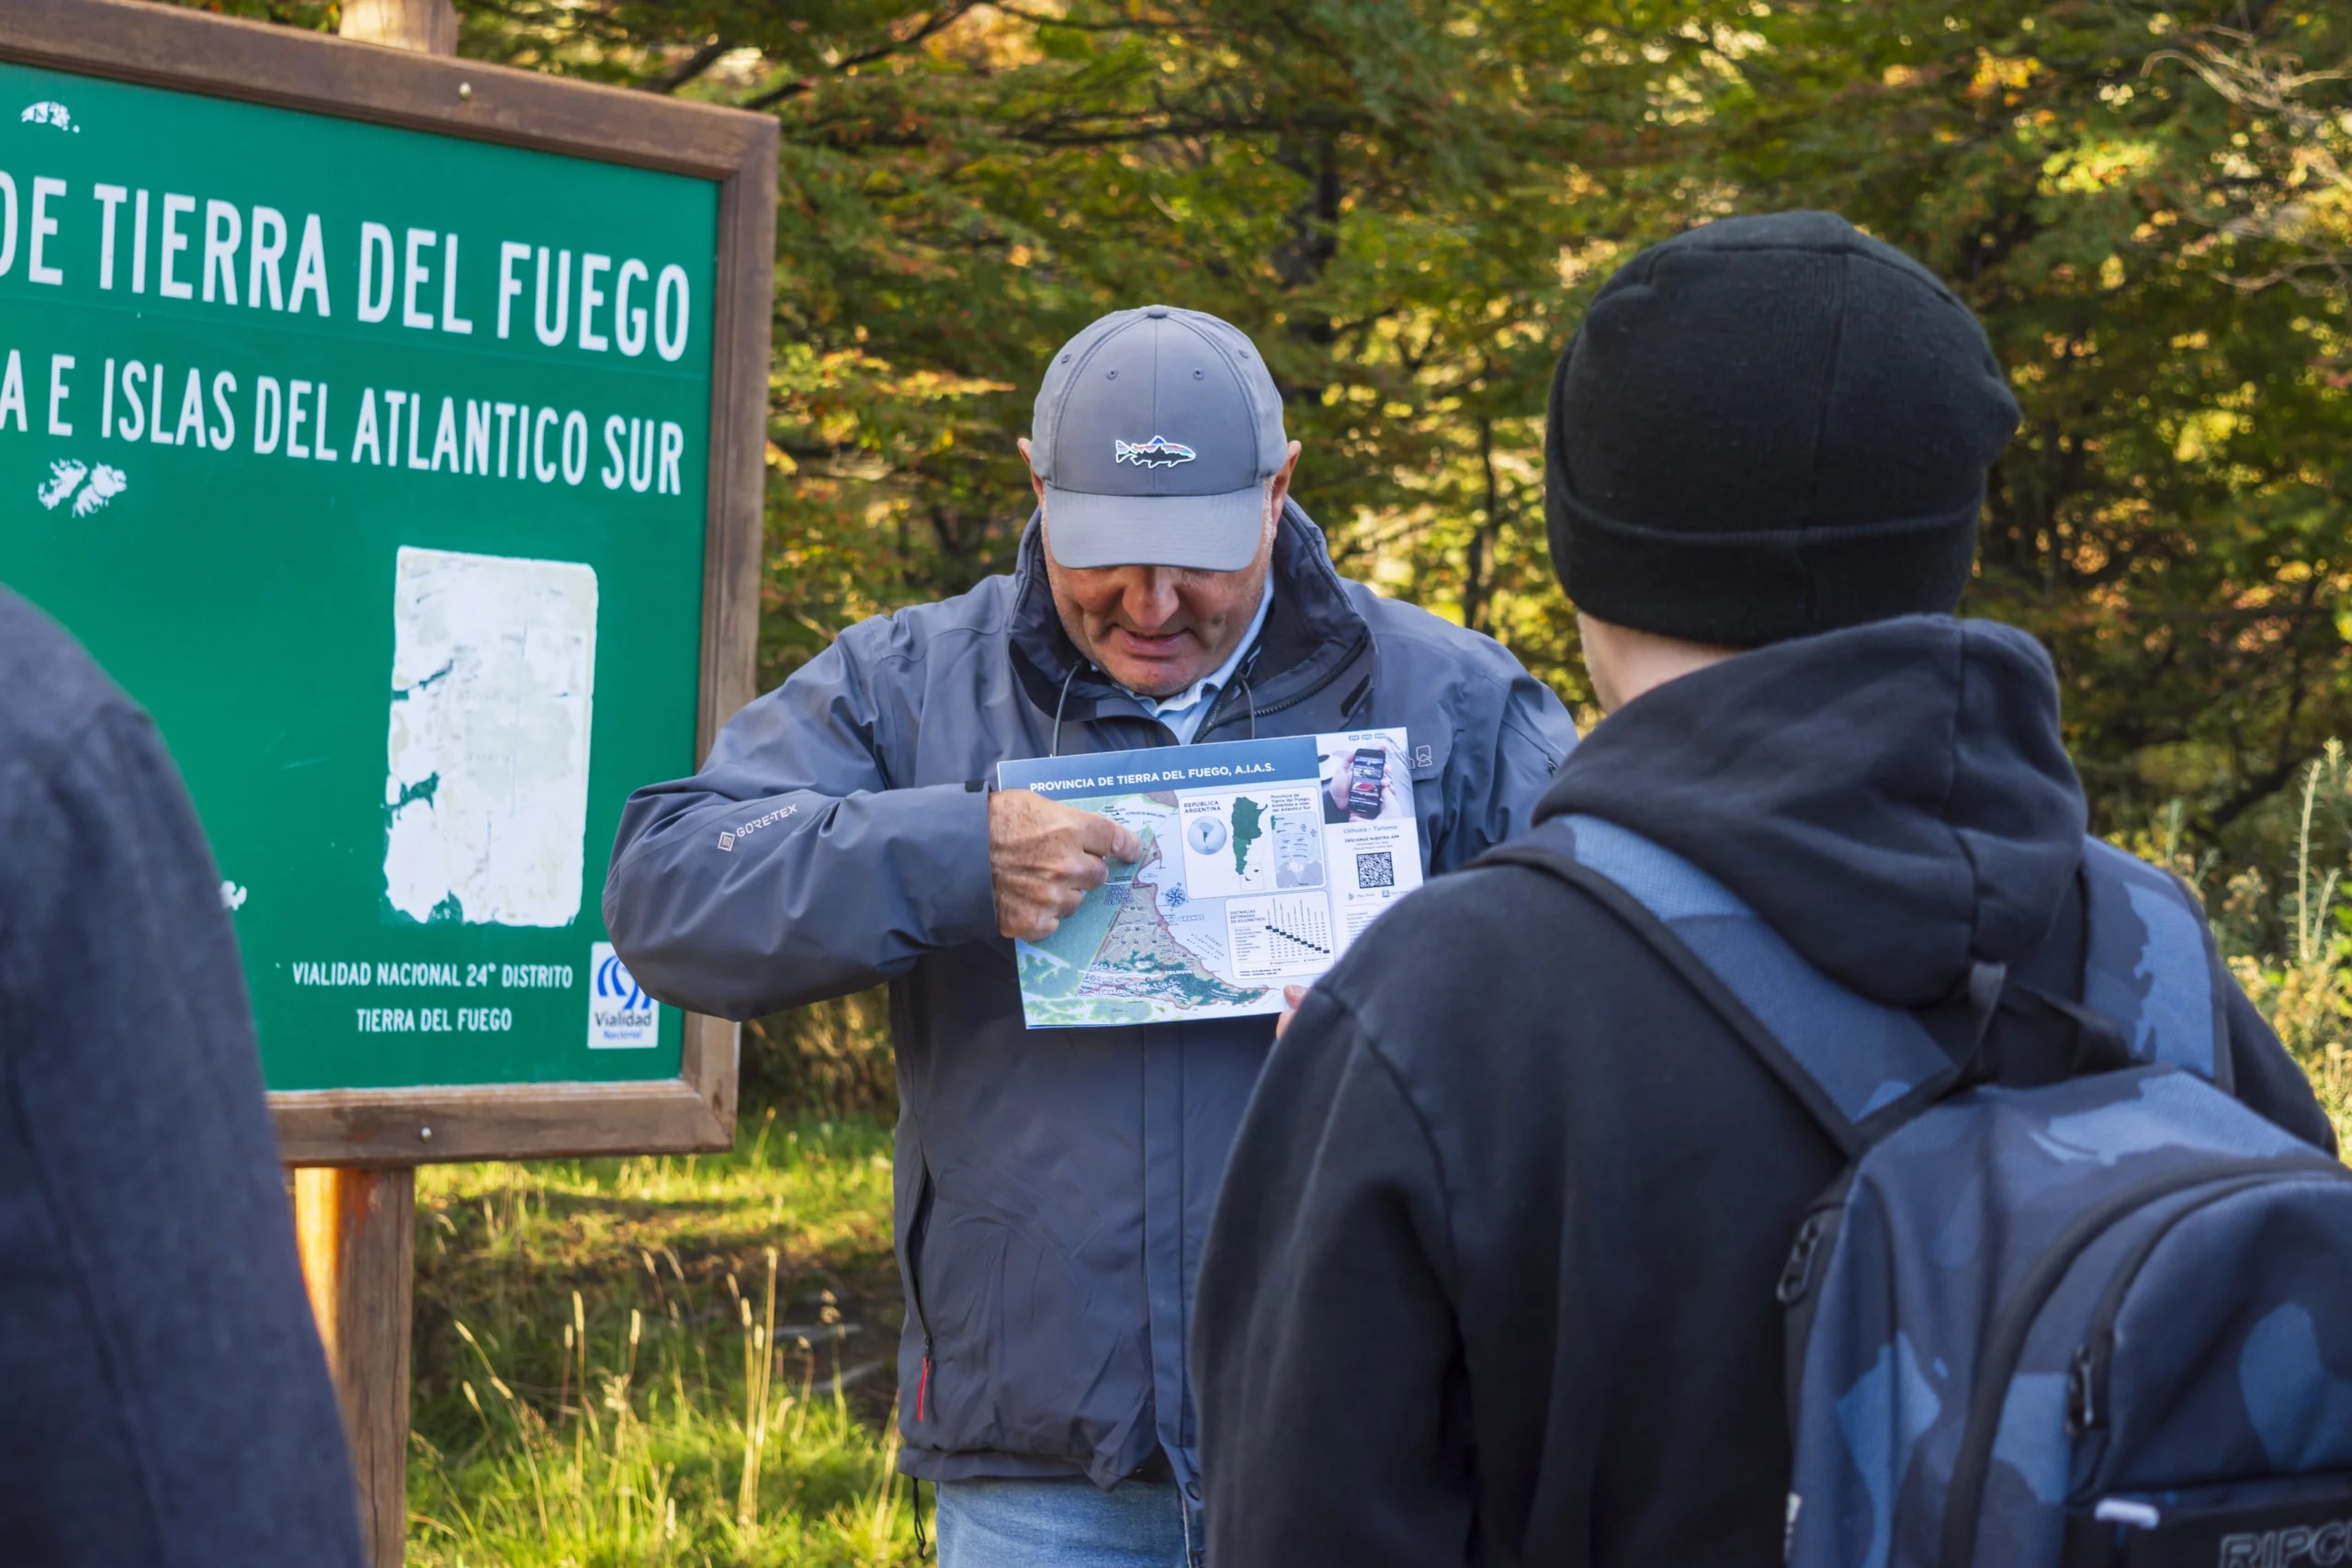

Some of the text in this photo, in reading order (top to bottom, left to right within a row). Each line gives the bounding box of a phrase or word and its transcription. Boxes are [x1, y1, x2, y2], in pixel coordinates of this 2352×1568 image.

[94, 184, 330, 317] TIERRA
[357, 221, 472, 333] DEL
[497, 242, 689, 361] FUEGO
[49, 355, 75, 436] E
[102, 358, 237, 451] ISLAS
[254, 376, 337, 461] DEL
[351, 388, 588, 485] ATLANTICO
[602, 415, 684, 495] SUR
[1030, 762, 1275, 793] PROVINCIA DE TIERRA DEL FUEGO, A.I.A.S.
[736, 804, 797, 838] GORE-TEX
[292, 962, 371, 986] VIALIDAD
[377, 963, 461, 987] NACIONAL
[502, 964, 573, 988] DISTRITO
[356, 1008, 512, 1032] TIERRA DEL FUEGO
[594, 1011, 652, 1027] Vialidad
[2221, 1519, 2352, 1568] RIPC
